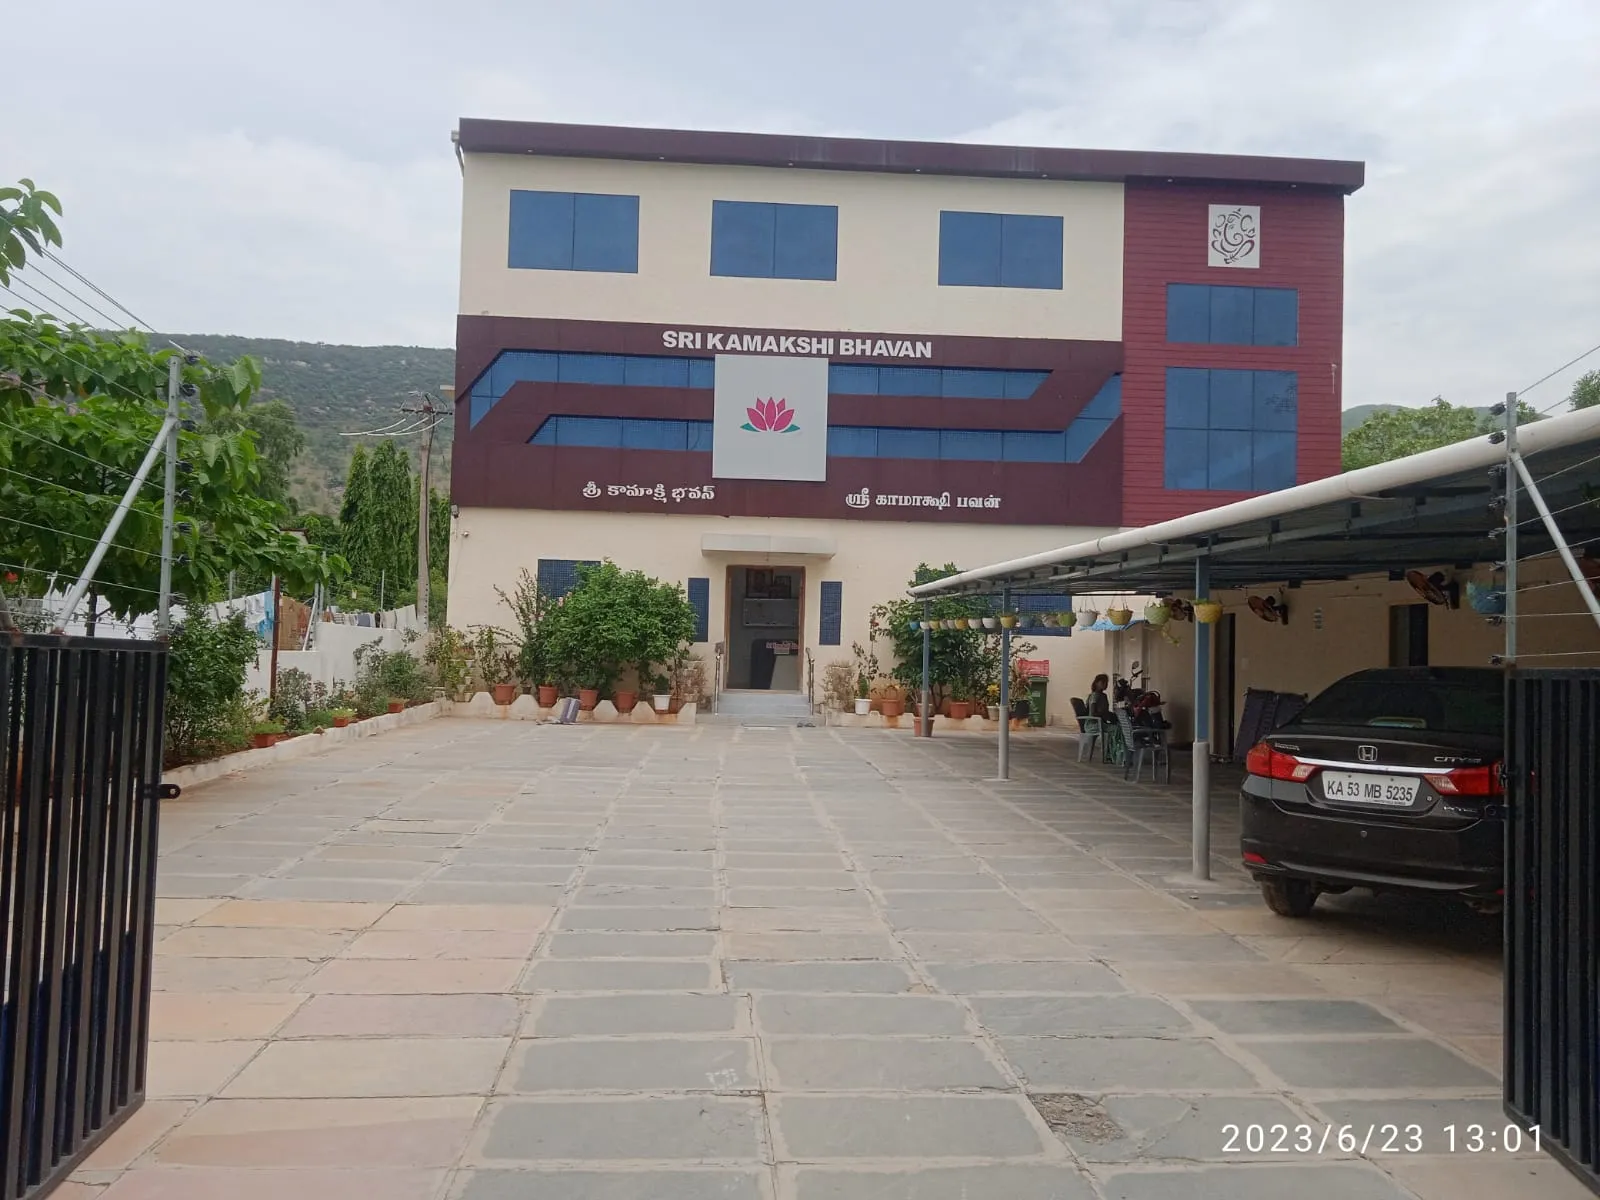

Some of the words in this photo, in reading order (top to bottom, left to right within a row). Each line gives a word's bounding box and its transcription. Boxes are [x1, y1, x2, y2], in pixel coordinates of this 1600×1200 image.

[662, 330, 701, 350] SRI
[707, 333, 834, 355] KAMAKSHI
[839, 338, 932, 358] BHAVAN
[582, 481, 601, 498] శ్రీ
[607, 483, 667, 503] కామాక్షి
[671, 485, 715, 502] భవన్
[875, 492, 951, 510] காமாக்ஷி
[956, 494, 1001, 509] பவன்
[1327, 781, 1343, 796] KA
[1347, 782, 1360, 797] 53
[1364, 784, 1381, 799] MB
[1386, 785, 1413, 801] 5235
